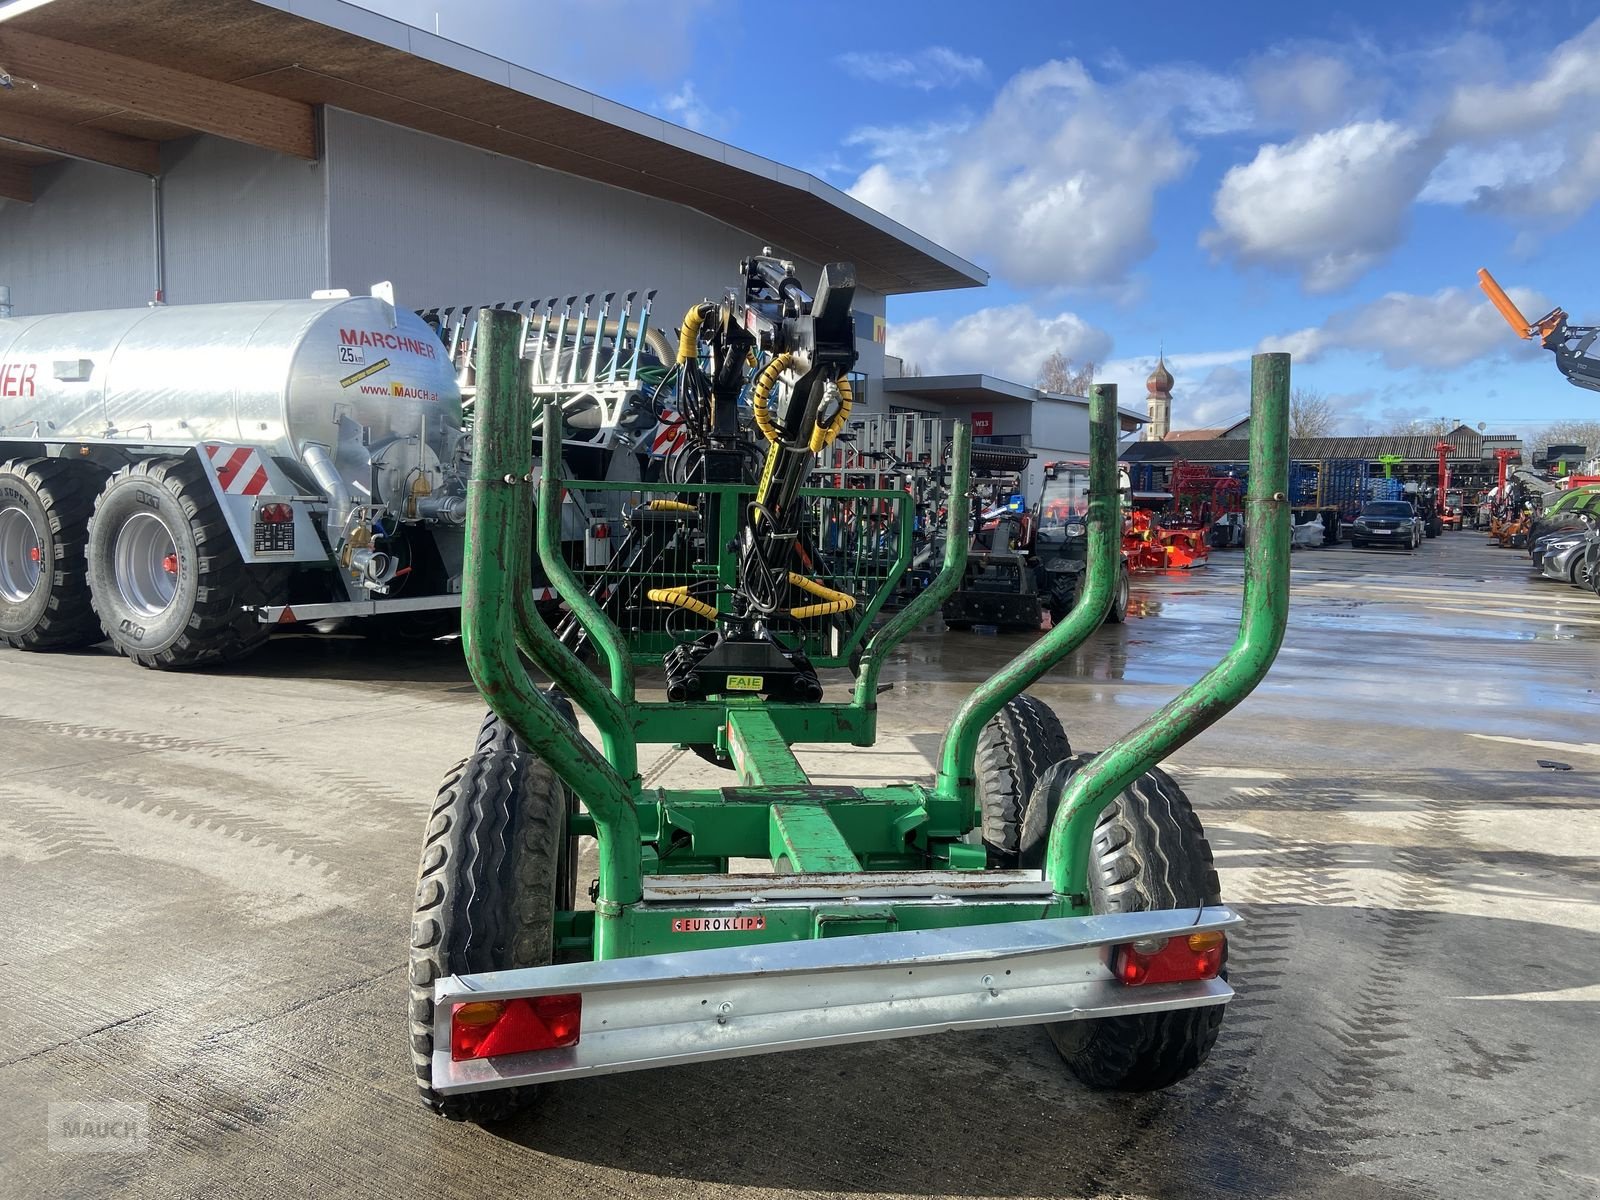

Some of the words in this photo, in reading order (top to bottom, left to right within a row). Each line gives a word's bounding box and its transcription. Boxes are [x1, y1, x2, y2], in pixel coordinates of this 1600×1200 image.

[340, 329, 436, 359] MARCHNER
[340, 347, 354, 362] 25
[4, 487, 29, 510] SUPER
[136, 489, 160, 510] BKT
[119, 619, 146, 641] BKT
[729, 677, 761, 687] FAIE
[685, 918, 753, 931] EUROKLIP
